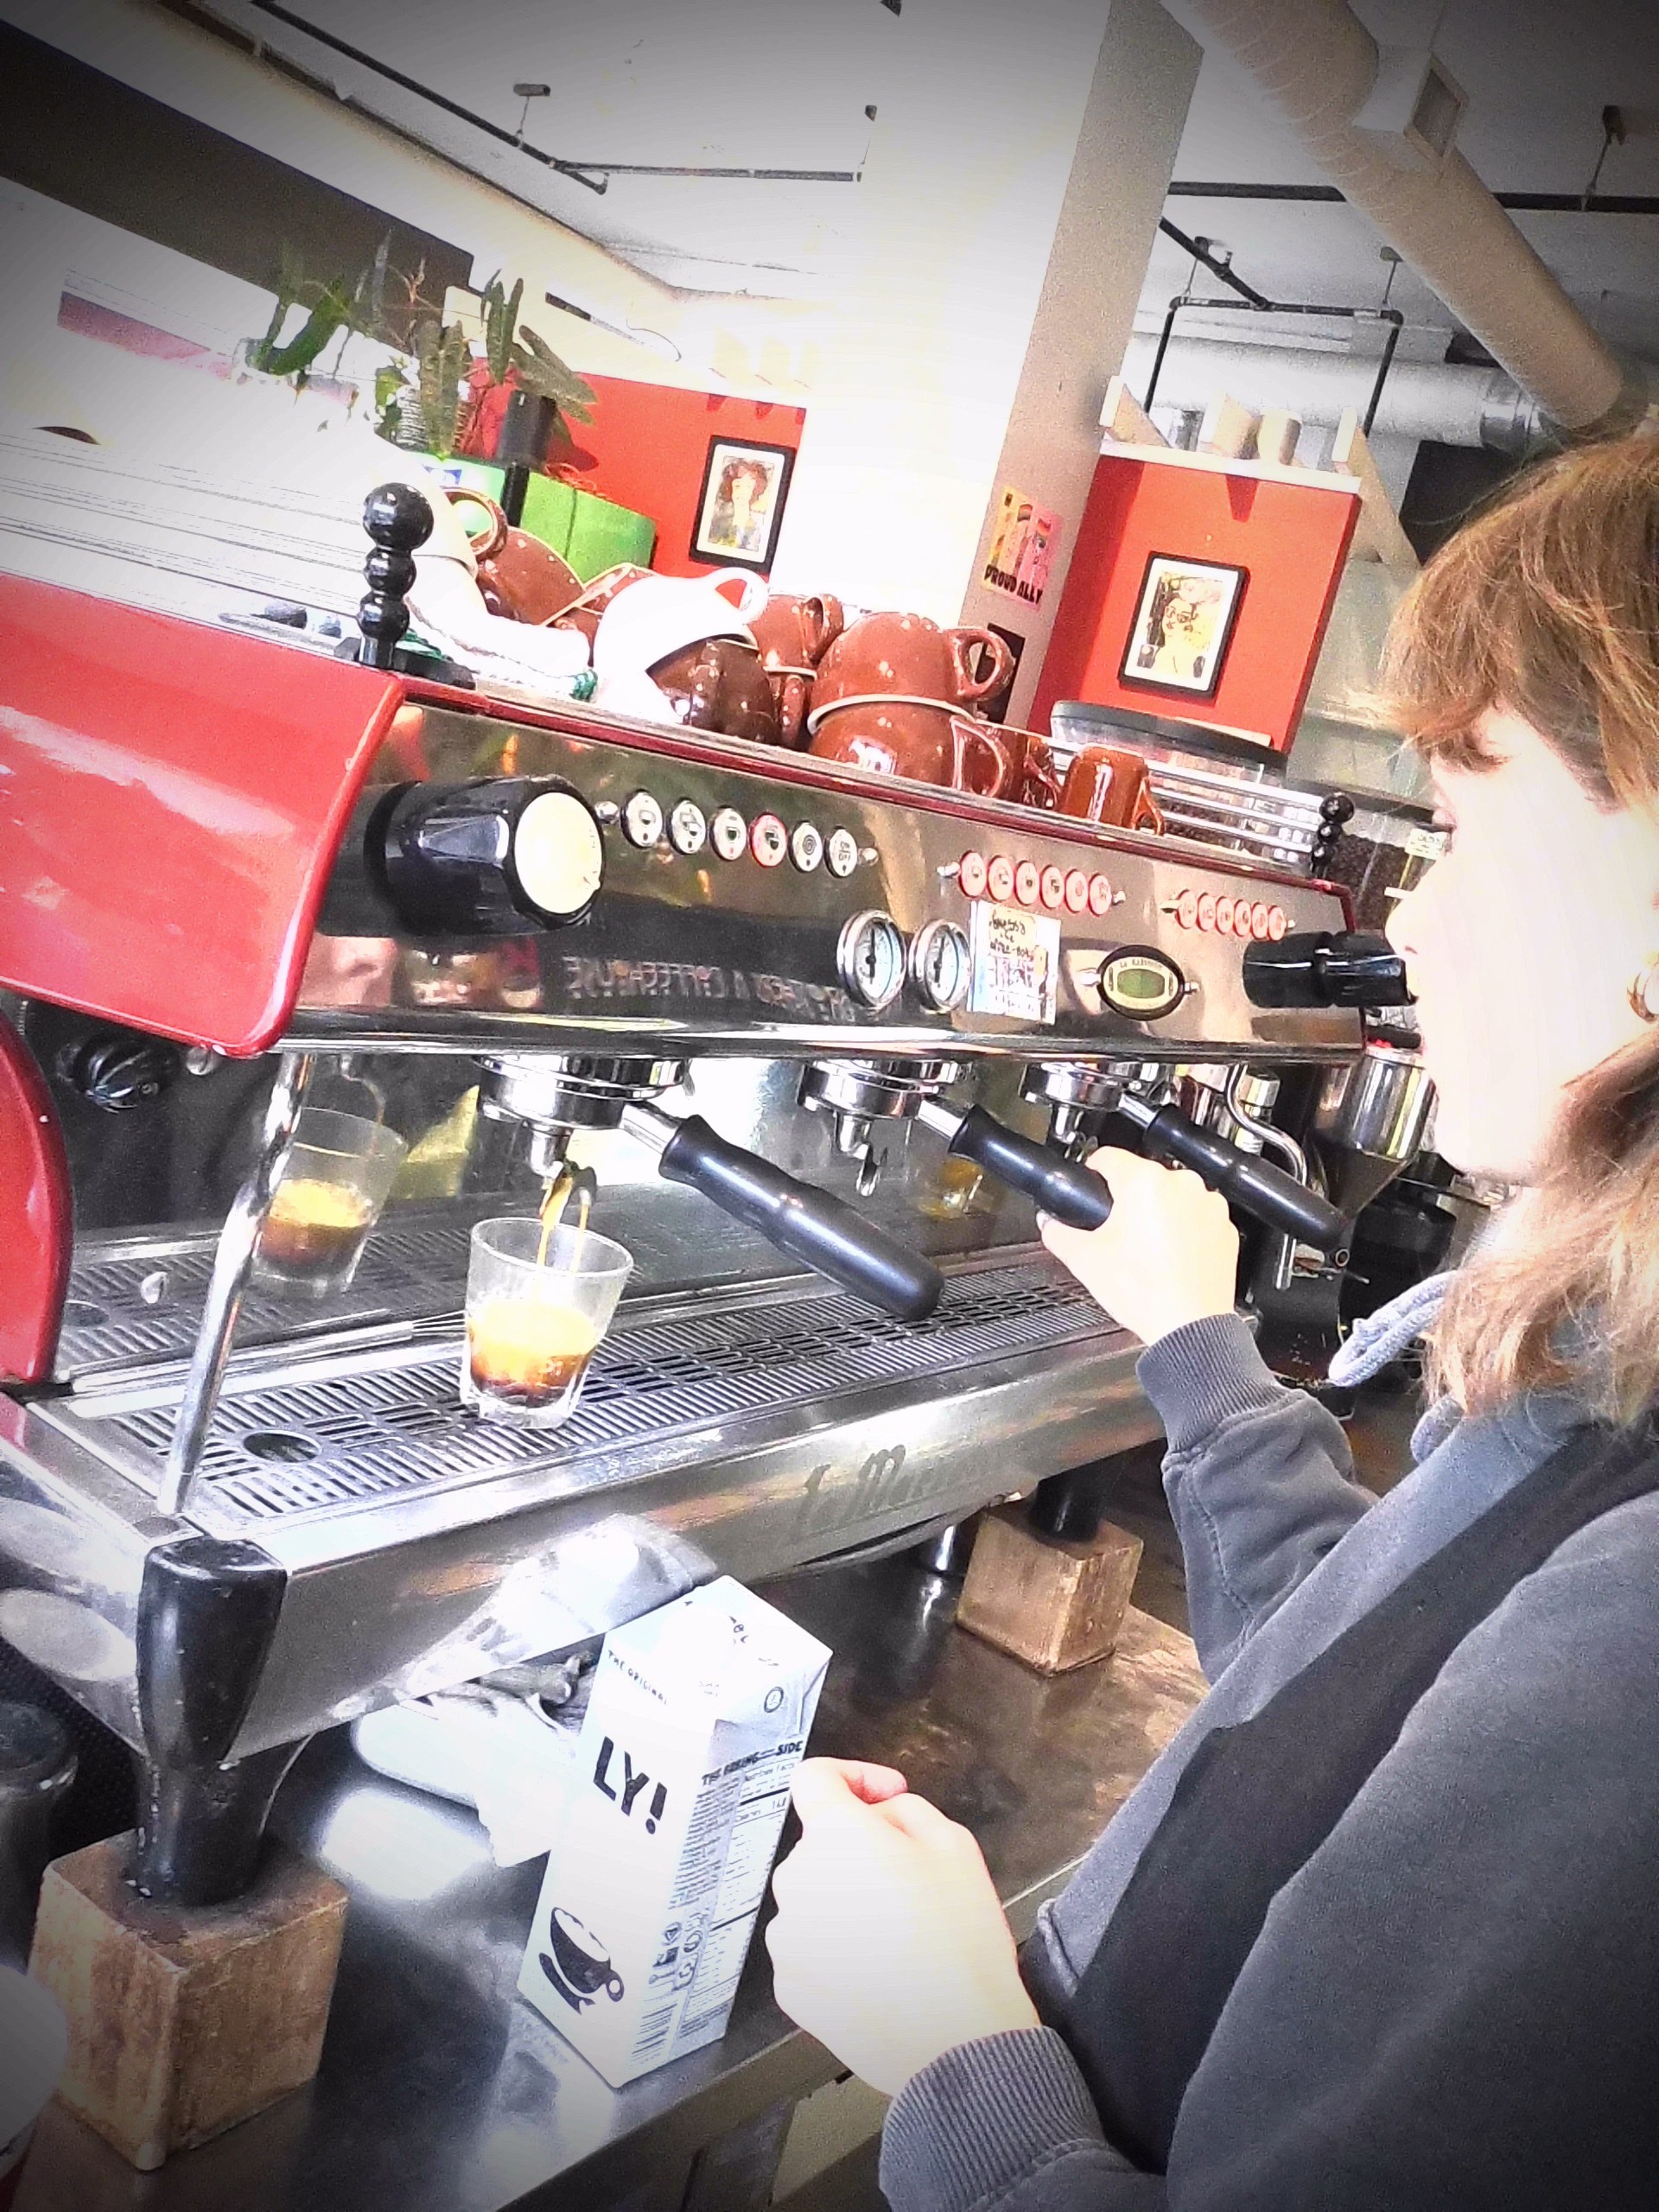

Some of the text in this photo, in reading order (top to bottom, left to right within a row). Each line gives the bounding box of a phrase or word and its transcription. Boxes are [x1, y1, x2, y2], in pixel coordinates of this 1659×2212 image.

[984, 564, 1043, 604] PROUD ALLY
[608, 1649, 626, 1671] THE
[627, 1668, 668, 1706] ORIGINAL
[776, 1740, 804, 1756] SIDE
[594, 1736, 667, 1834] LY!
